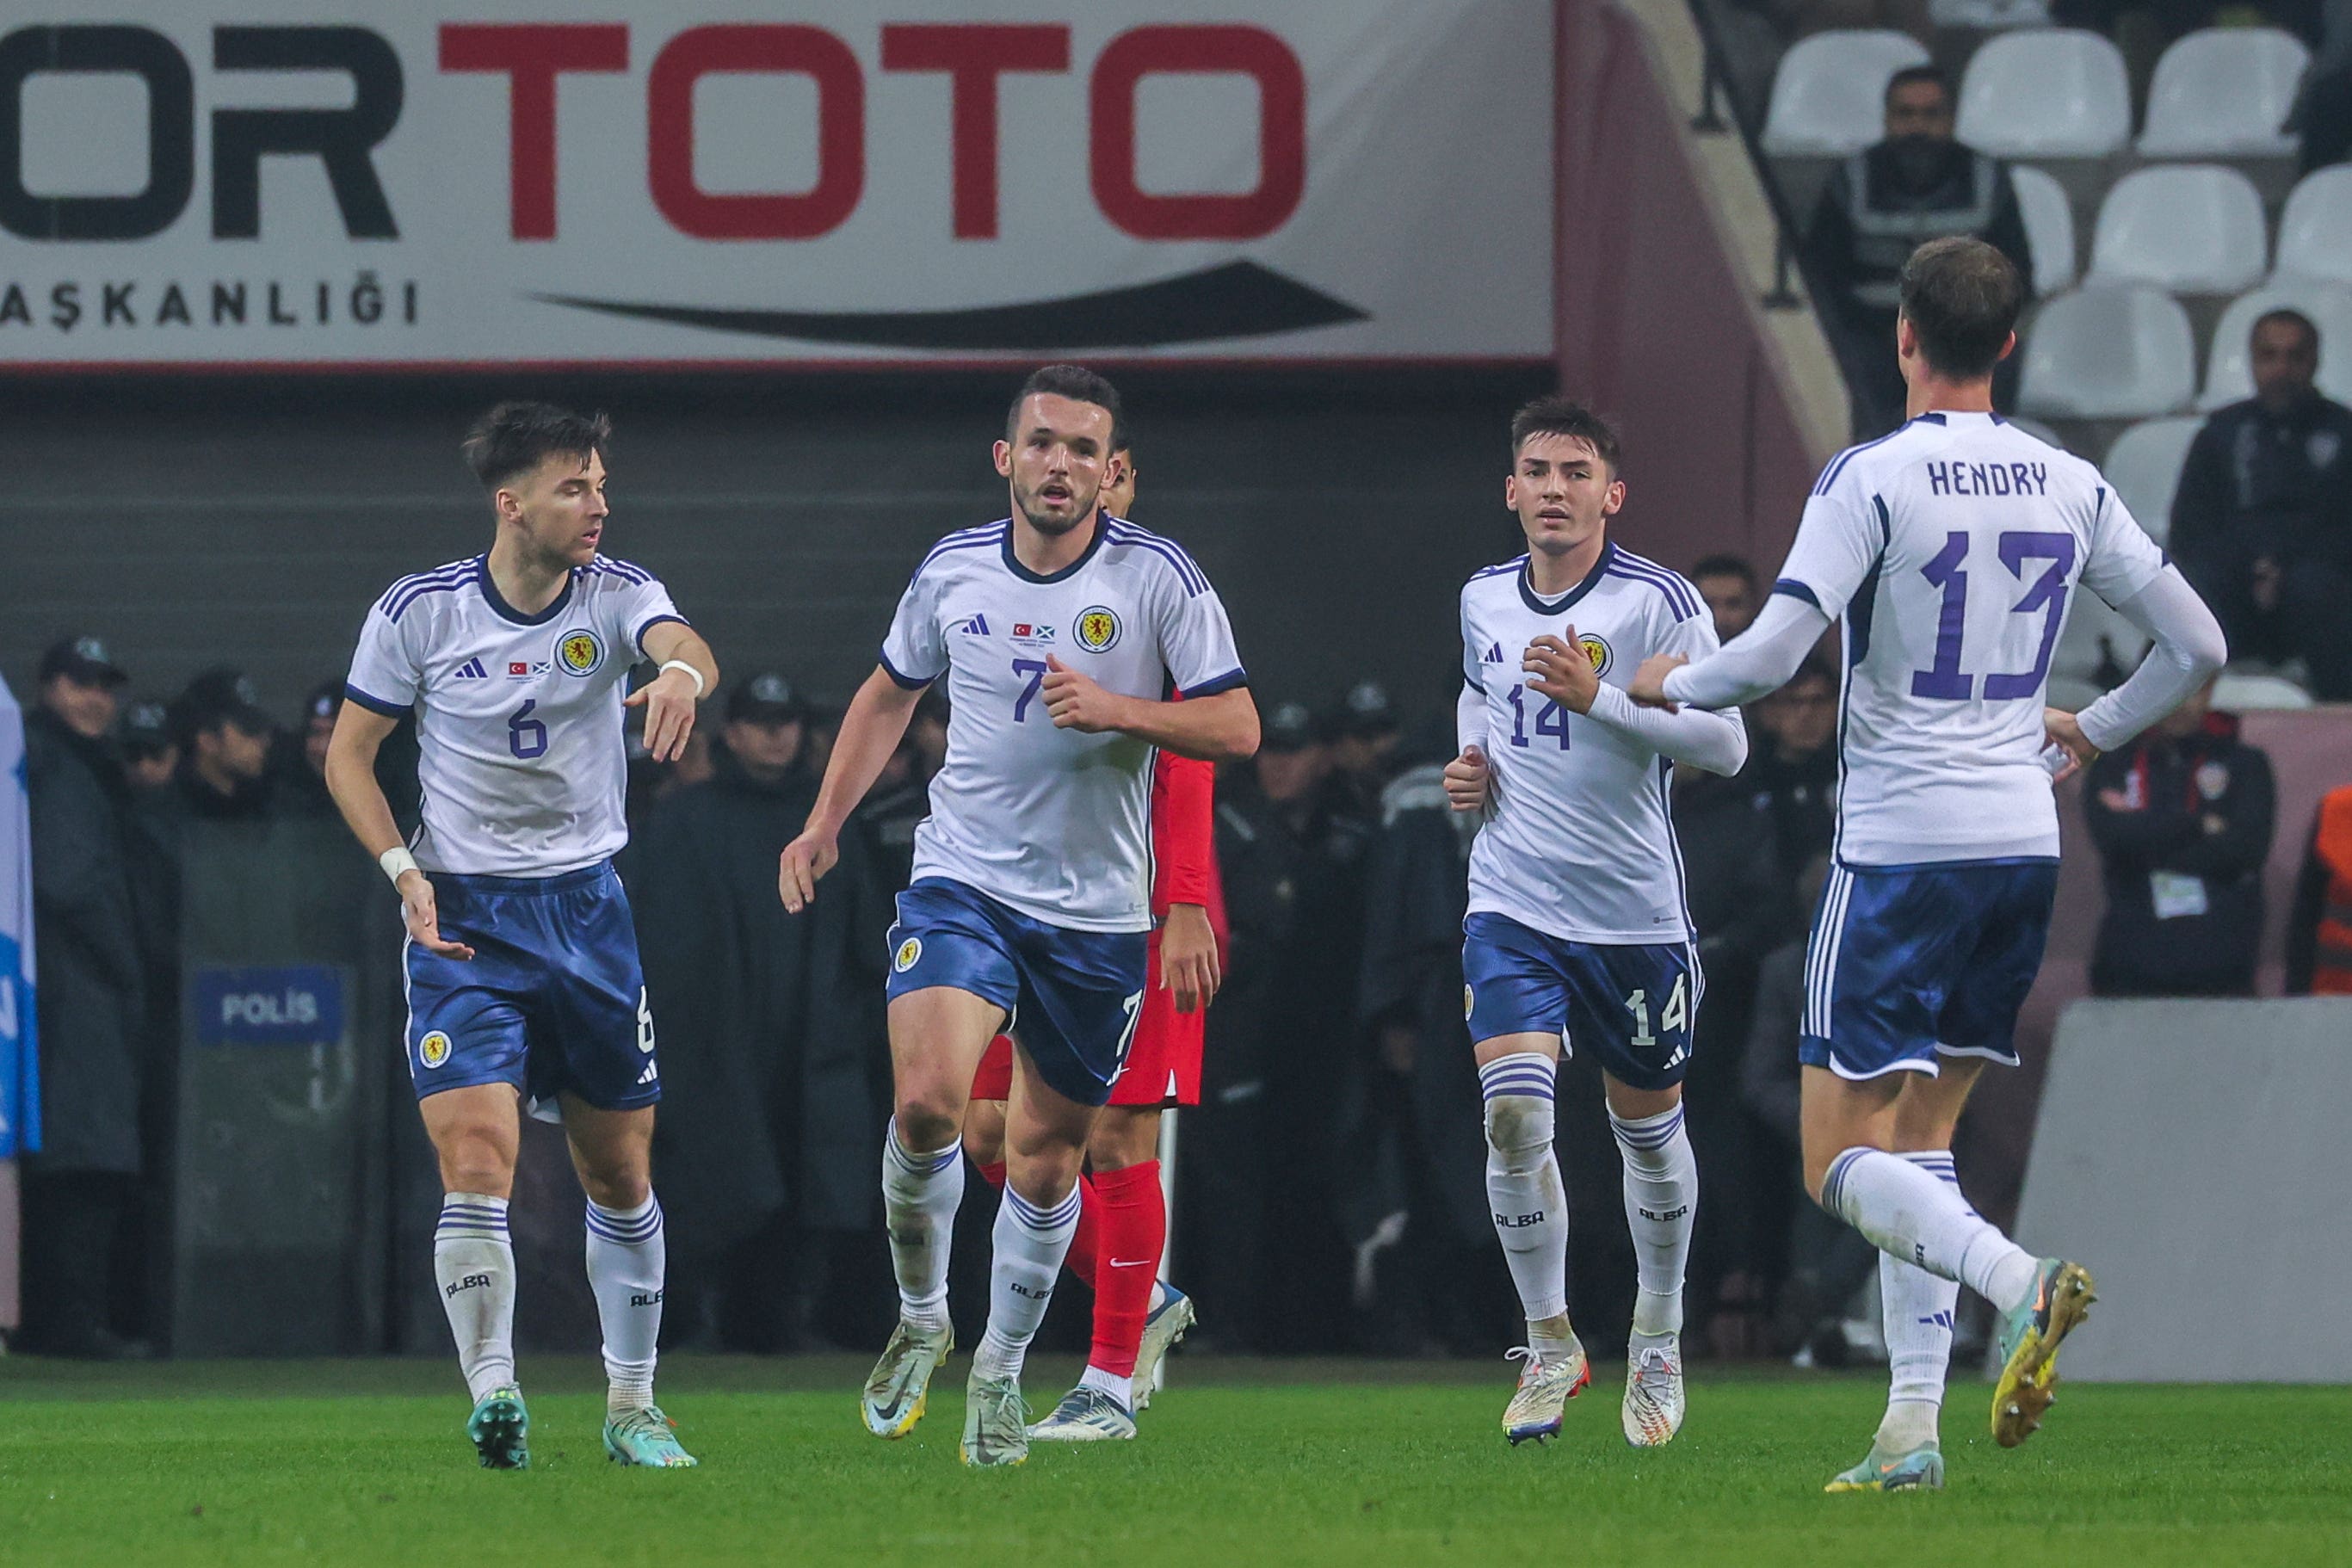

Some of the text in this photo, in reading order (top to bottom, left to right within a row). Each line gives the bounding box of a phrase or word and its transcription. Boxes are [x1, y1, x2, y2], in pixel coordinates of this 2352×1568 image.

[0, 23, 1307, 242] OR TOTO
[1927, 461, 2046, 497] HENDRY
[1911, 530, 2076, 701] 13
[1011, 658, 1047, 723] 7
[1507, 683, 1571, 751] 14
[508, 698, 548, 759] 6
[637, 985, 655, 1054] 6
[1115, 988, 1143, 1058] 7
[1624, 972, 1687, 1046] 14
[1495, 1210, 1545, 1228] ALBA
[1639, 1204, 1688, 1222] ALBA
[446, 1274, 491, 1299] ALBA
